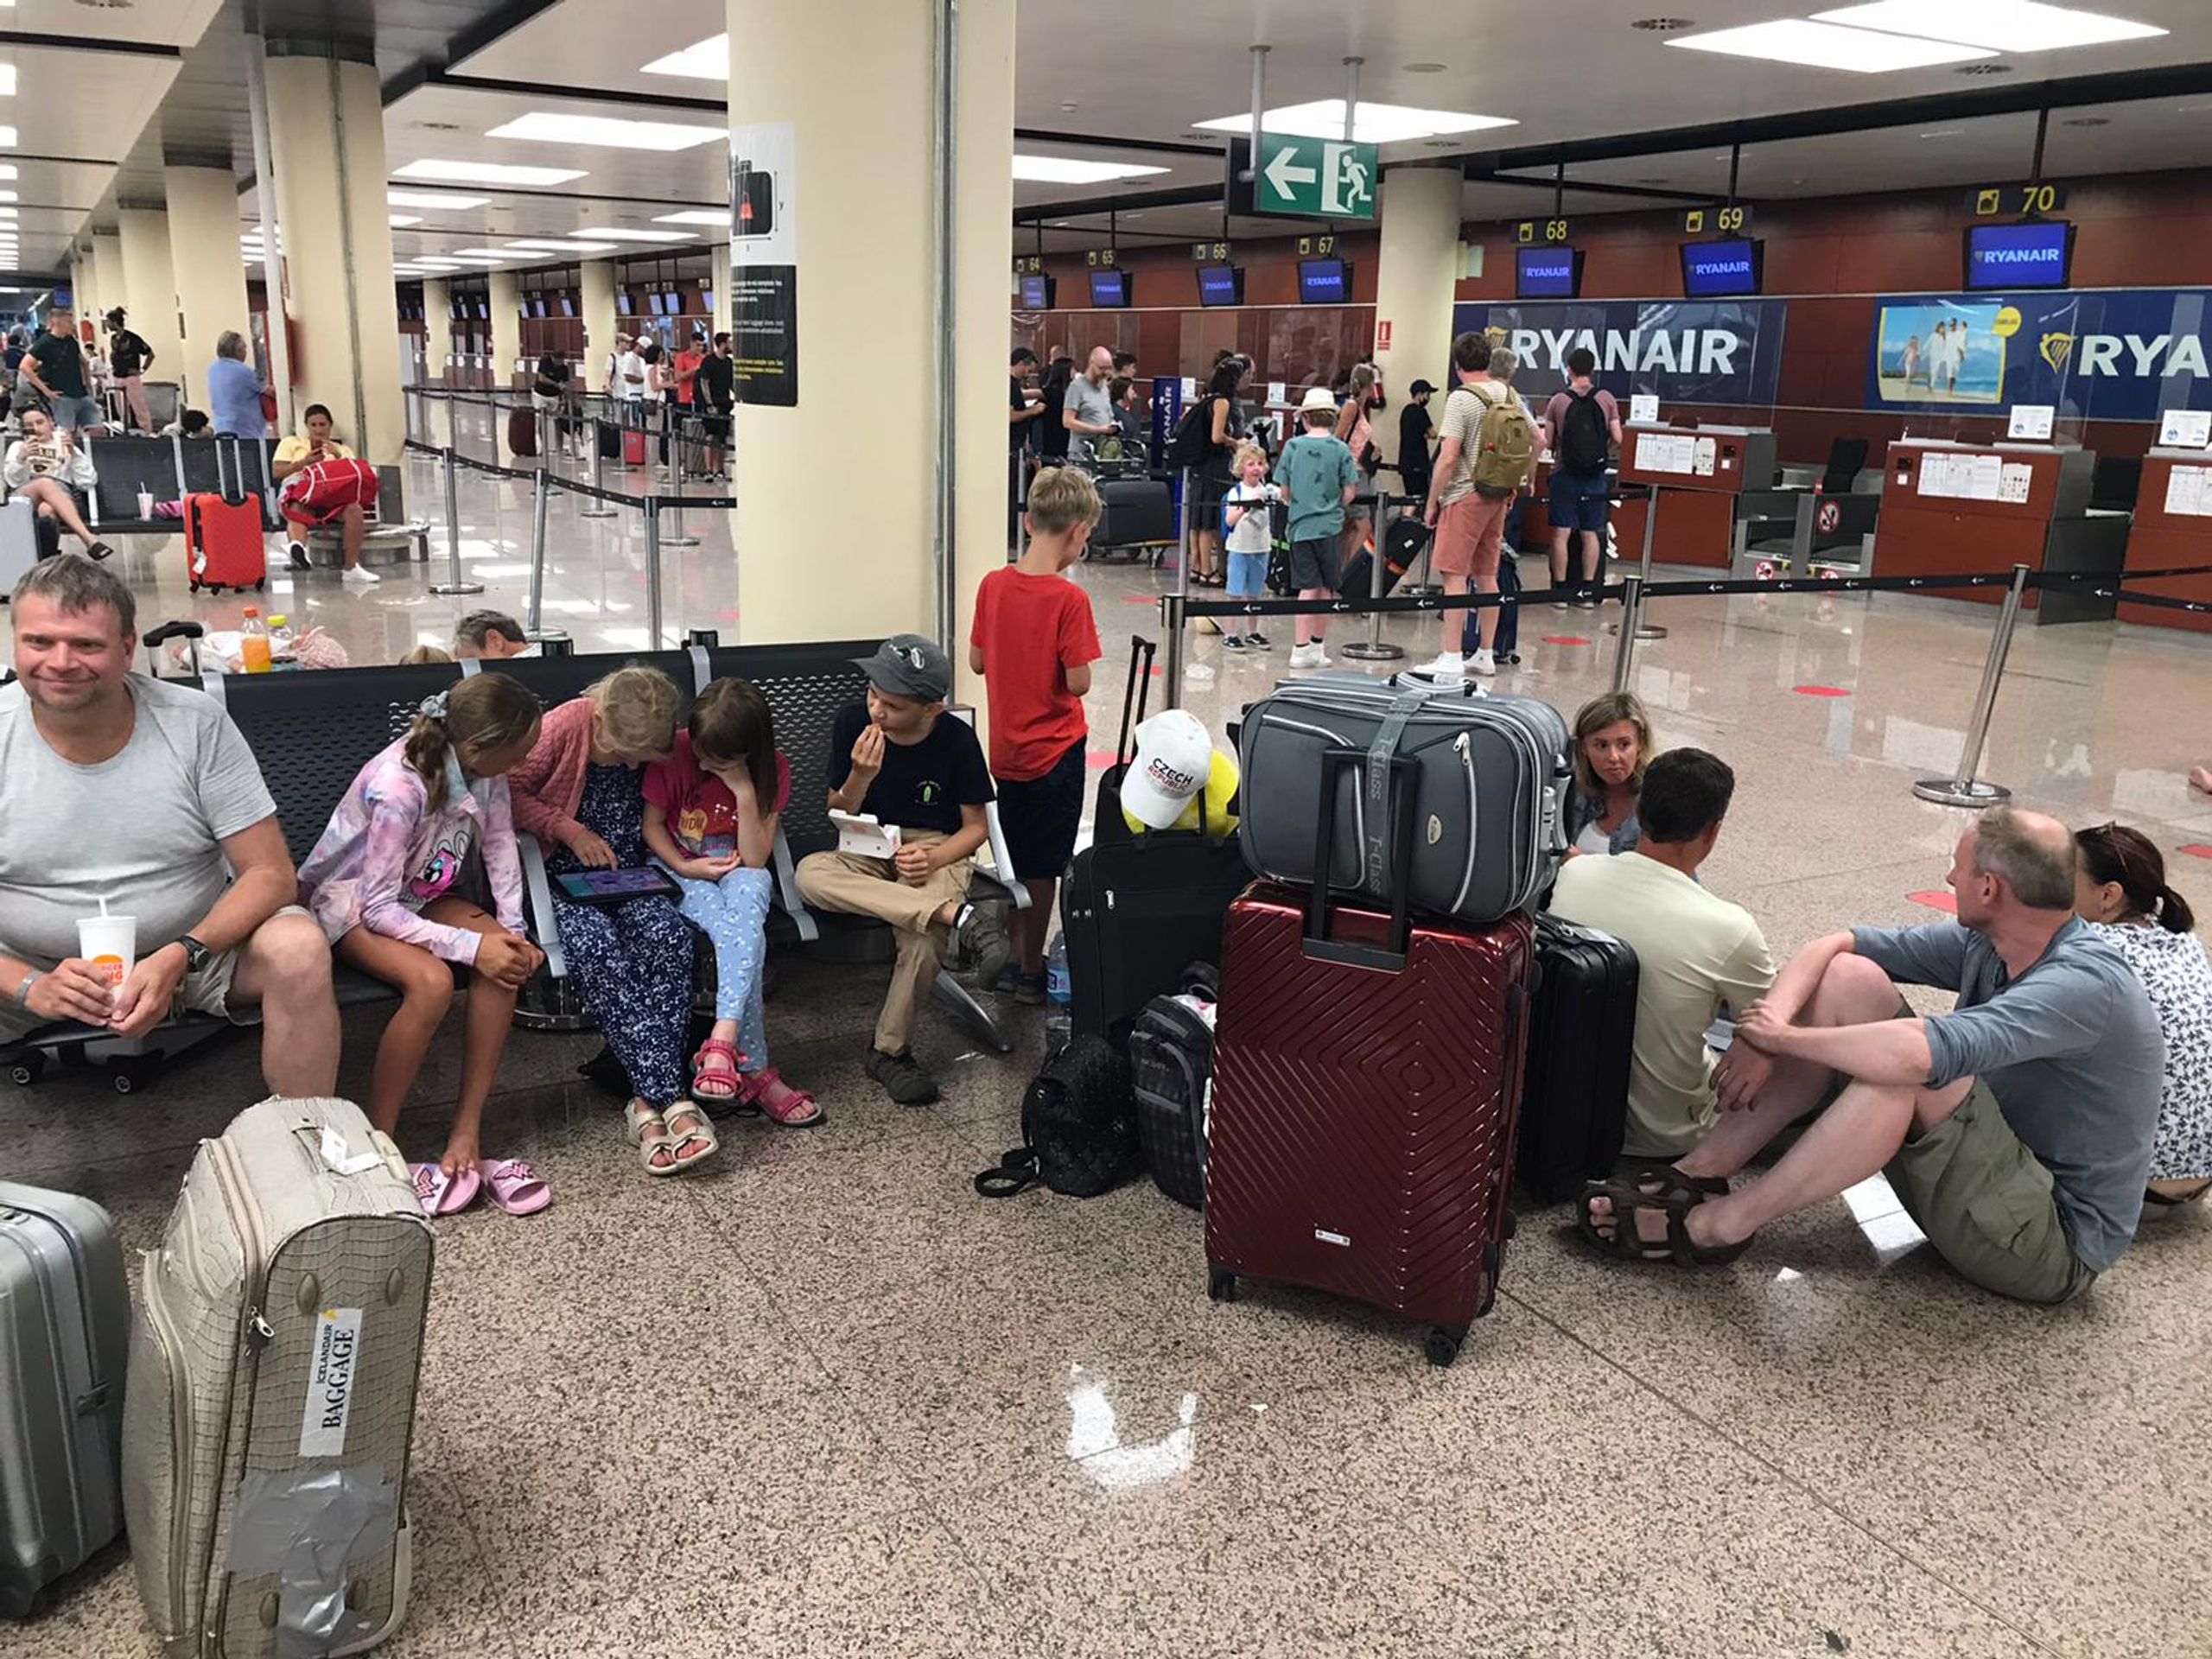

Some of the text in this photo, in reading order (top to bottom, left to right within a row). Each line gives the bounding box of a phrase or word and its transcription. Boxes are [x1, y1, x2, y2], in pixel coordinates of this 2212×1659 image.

[2023, 185, 2056, 213] 70
[1546, 220, 1567, 240] 68
[1719, 207, 1744, 230] 69
[1213, 243, 1226, 259] 66
[1319, 236, 1334, 254] 67
[1984, 248, 2060, 264] RYANAIR
[1526, 266, 1570, 277] RYANAIR
[1695, 261, 1750, 276] RYANAIR
[1153, 757, 1194, 785] CZECH
[1370, 737, 1395, 801] T-Class
[1368, 834, 1383, 895] T-Class
[316, 1324, 333, 1384] ICELANDAIR
[321, 1329, 354, 1429] BAGGAGE
